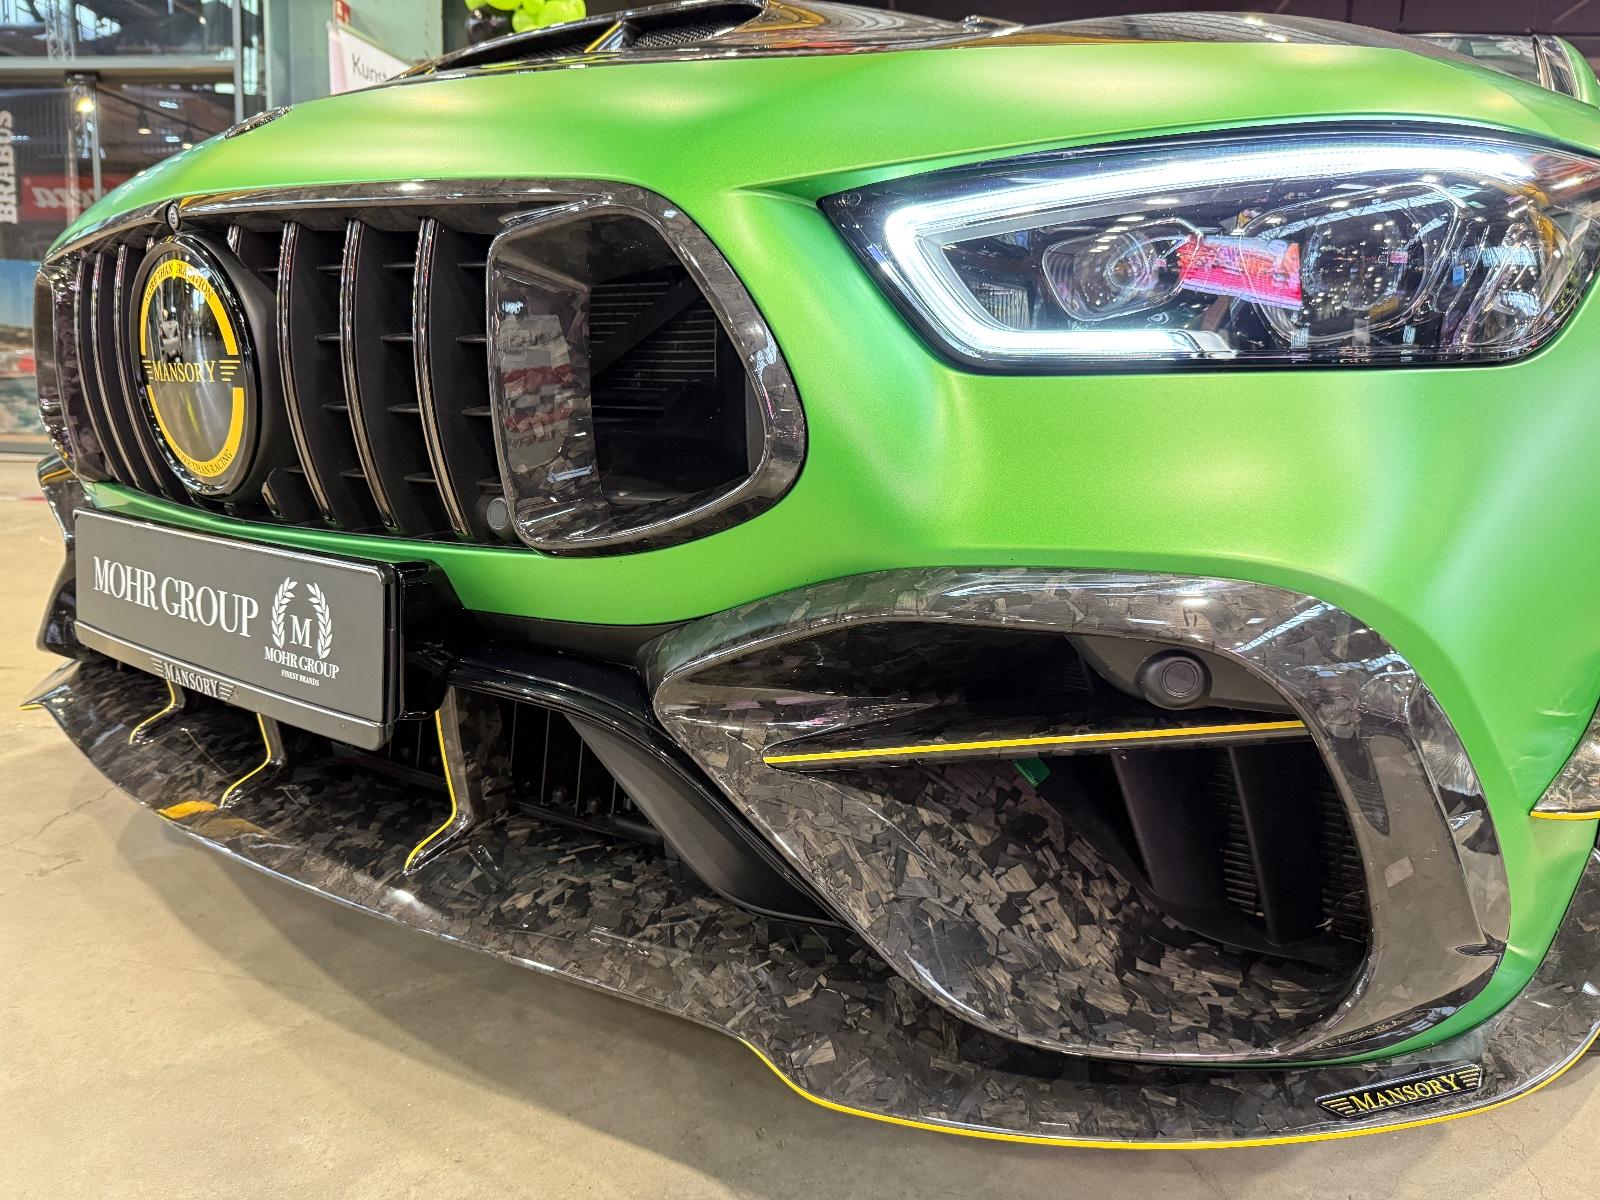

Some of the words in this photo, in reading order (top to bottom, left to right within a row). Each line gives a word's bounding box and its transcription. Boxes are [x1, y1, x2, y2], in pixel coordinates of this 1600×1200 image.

[0, 110, 18, 224] BRABUS
[153, 360, 216, 383] MANSORY
[93, 556, 158, 611] MOHR
[161, 577, 259, 637] GROUP
[291, 615, 313, 648] M
[264, 646, 298, 668] MOHR
[299, 656, 340, 679] GROUP
[281, 669, 299, 681] FINEST
[300, 675, 320, 687] BRANDS
[164, 662, 219, 698] MANSORY
[1349, 1073, 1461, 1112] MANSORY
